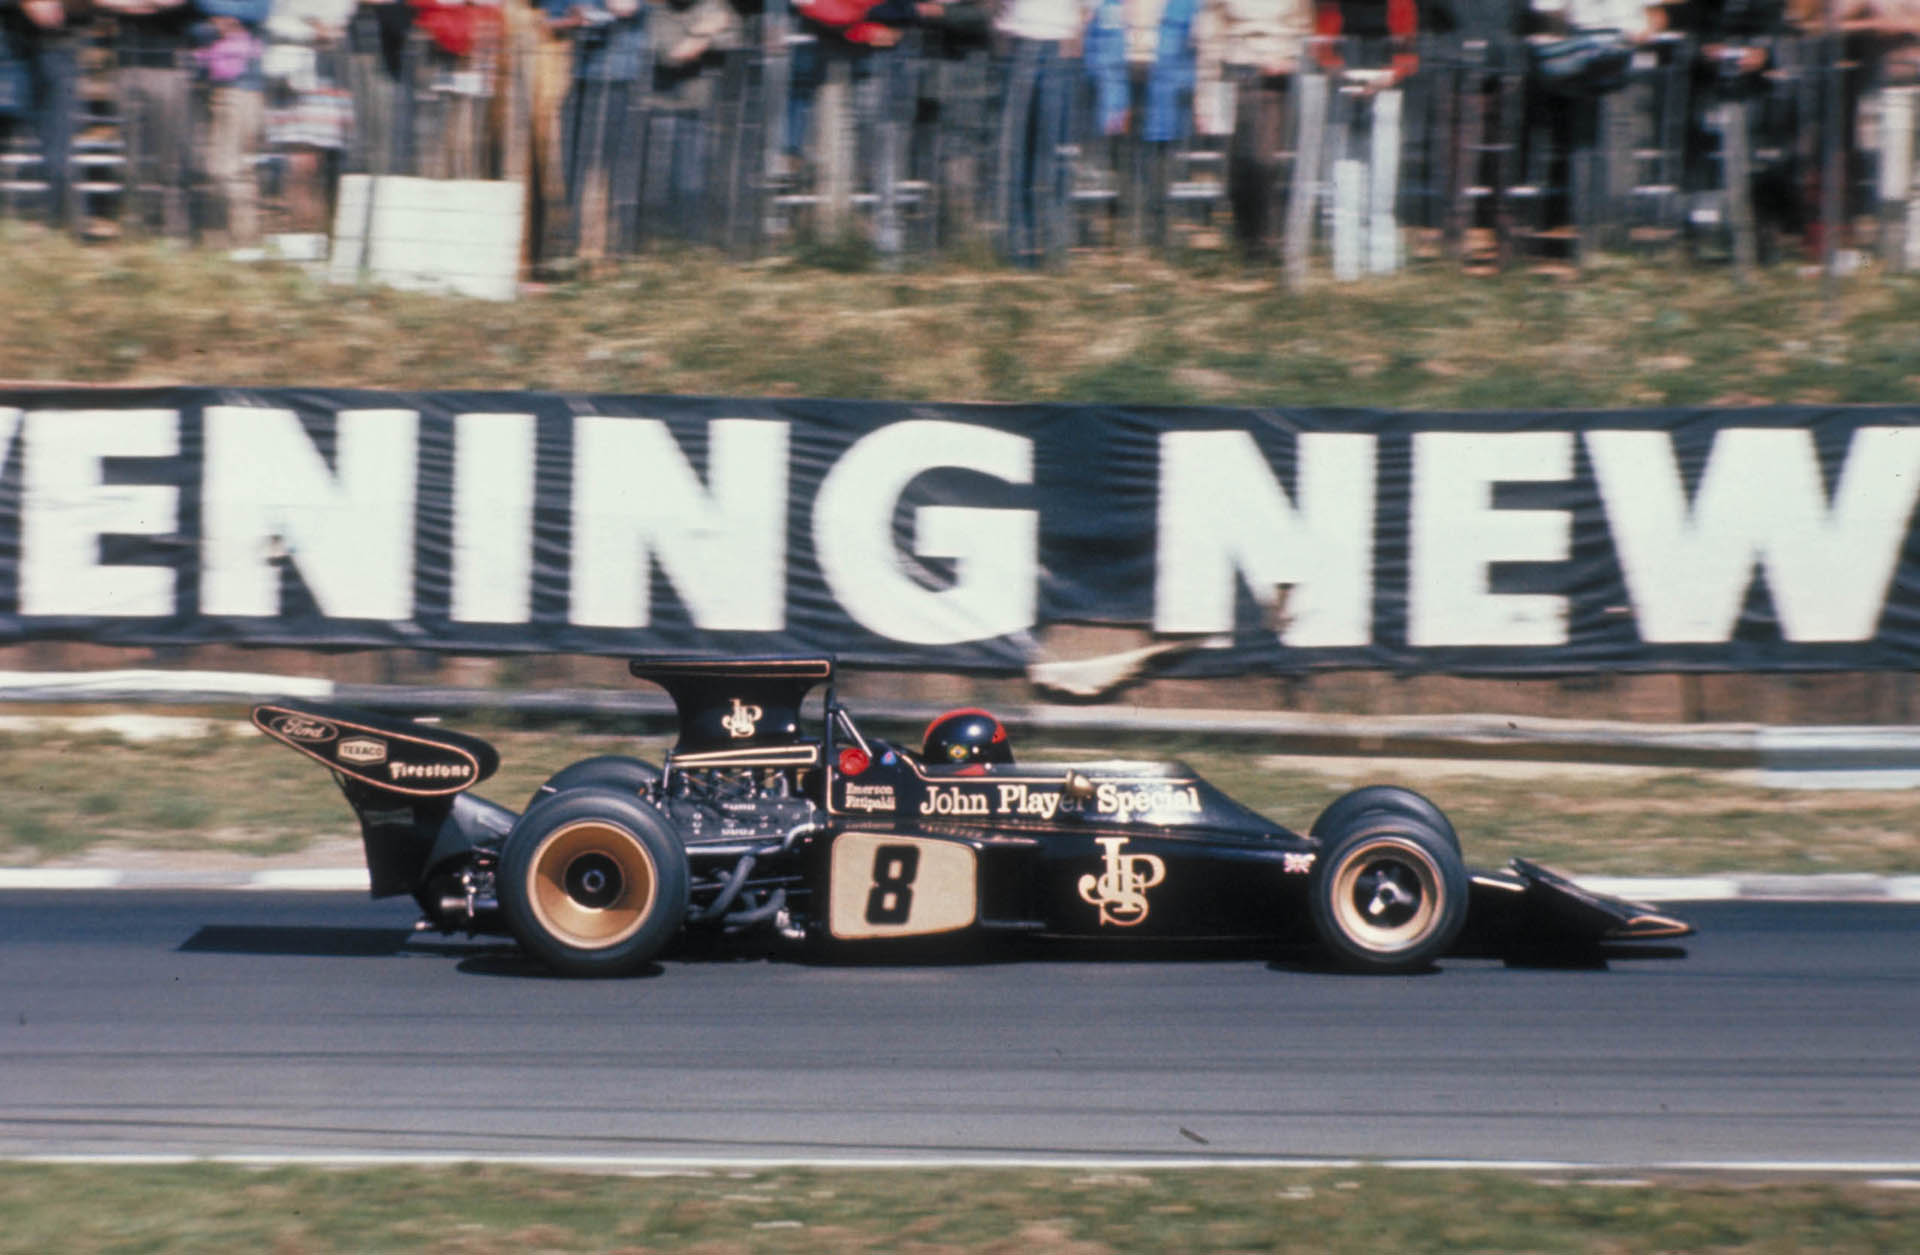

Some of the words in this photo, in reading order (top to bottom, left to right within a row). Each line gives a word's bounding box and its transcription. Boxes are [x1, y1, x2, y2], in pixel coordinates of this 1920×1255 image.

[0, 405, 1039, 645] ENING
[1153, 426, 1920, 648] NEW
[281, 717, 327, 738] Ford
[342, 745, 384, 757] TEXACO
[388, 762, 472, 780] Firestone
[845, 782, 895, 796] Emerson
[919, 786, 990, 814] John
[1096, 784, 1202, 823] Special
[864, 843, 921, 926] 8
